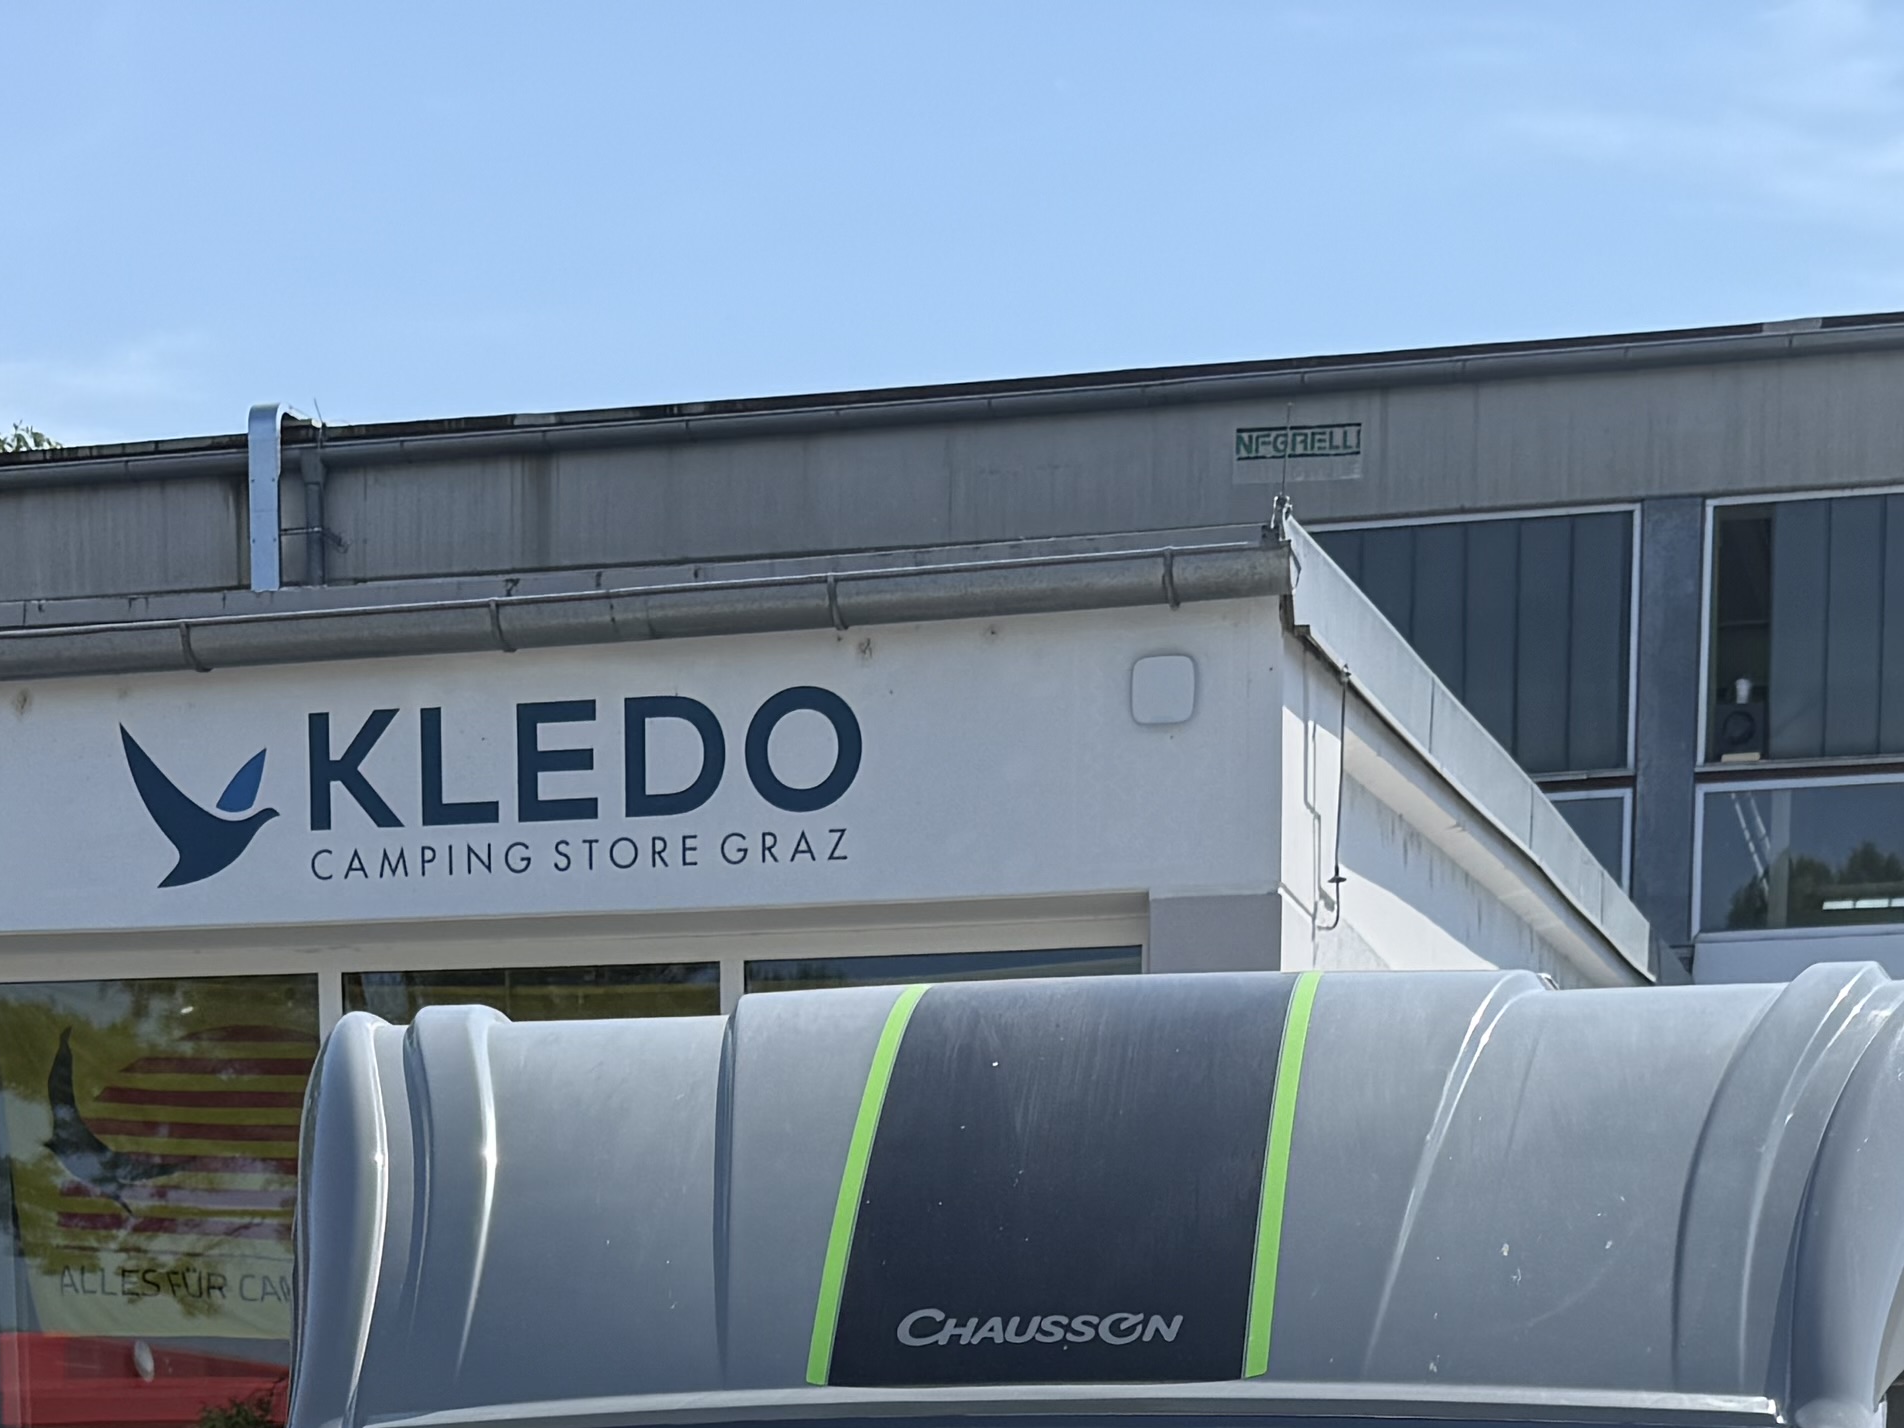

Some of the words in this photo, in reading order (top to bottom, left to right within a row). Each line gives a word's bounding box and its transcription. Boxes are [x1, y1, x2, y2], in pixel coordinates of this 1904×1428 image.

[307, 684, 864, 831] KLEDO
[310, 841, 533, 881] CAMPING
[552, 834, 699, 873] STORE
[719, 827, 850, 866] GRAZ
[59, 1264, 161, 1298] ALLES
[164, 1264, 228, 1300] FÜR
[895, 1307, 1185, 1347] CHAUSSON
